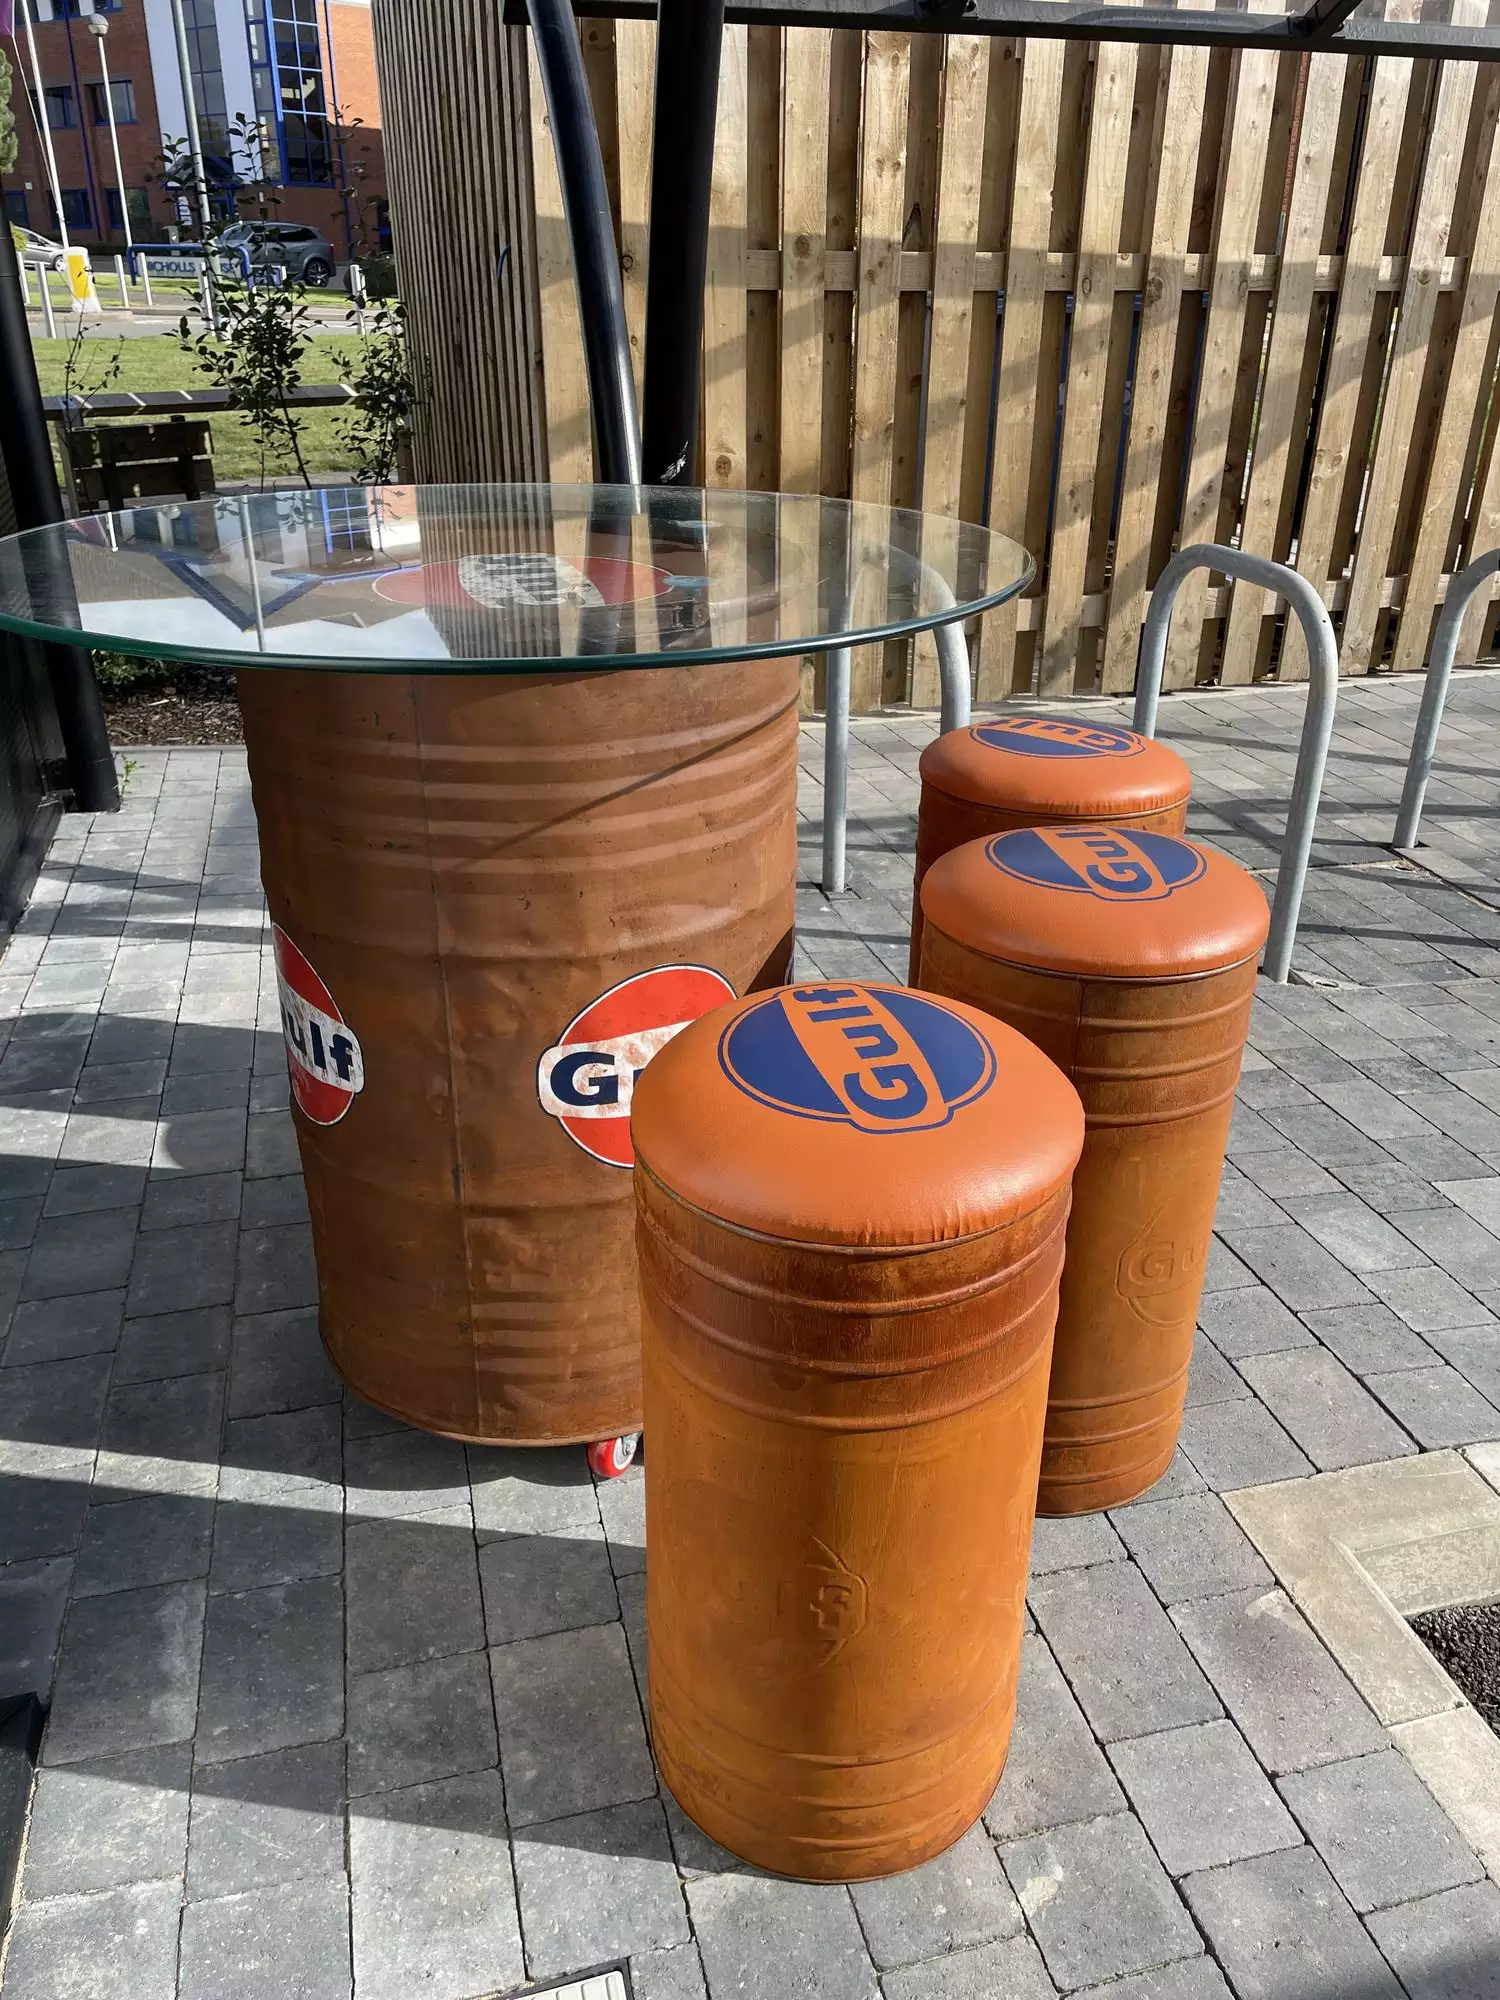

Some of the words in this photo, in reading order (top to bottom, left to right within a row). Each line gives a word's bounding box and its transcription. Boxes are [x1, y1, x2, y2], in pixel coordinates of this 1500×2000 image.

[281, 1001, 356, 1082] ulf
[549, 1050, 644, 1107] G
[793, 988, 928, 1120] Gulf
